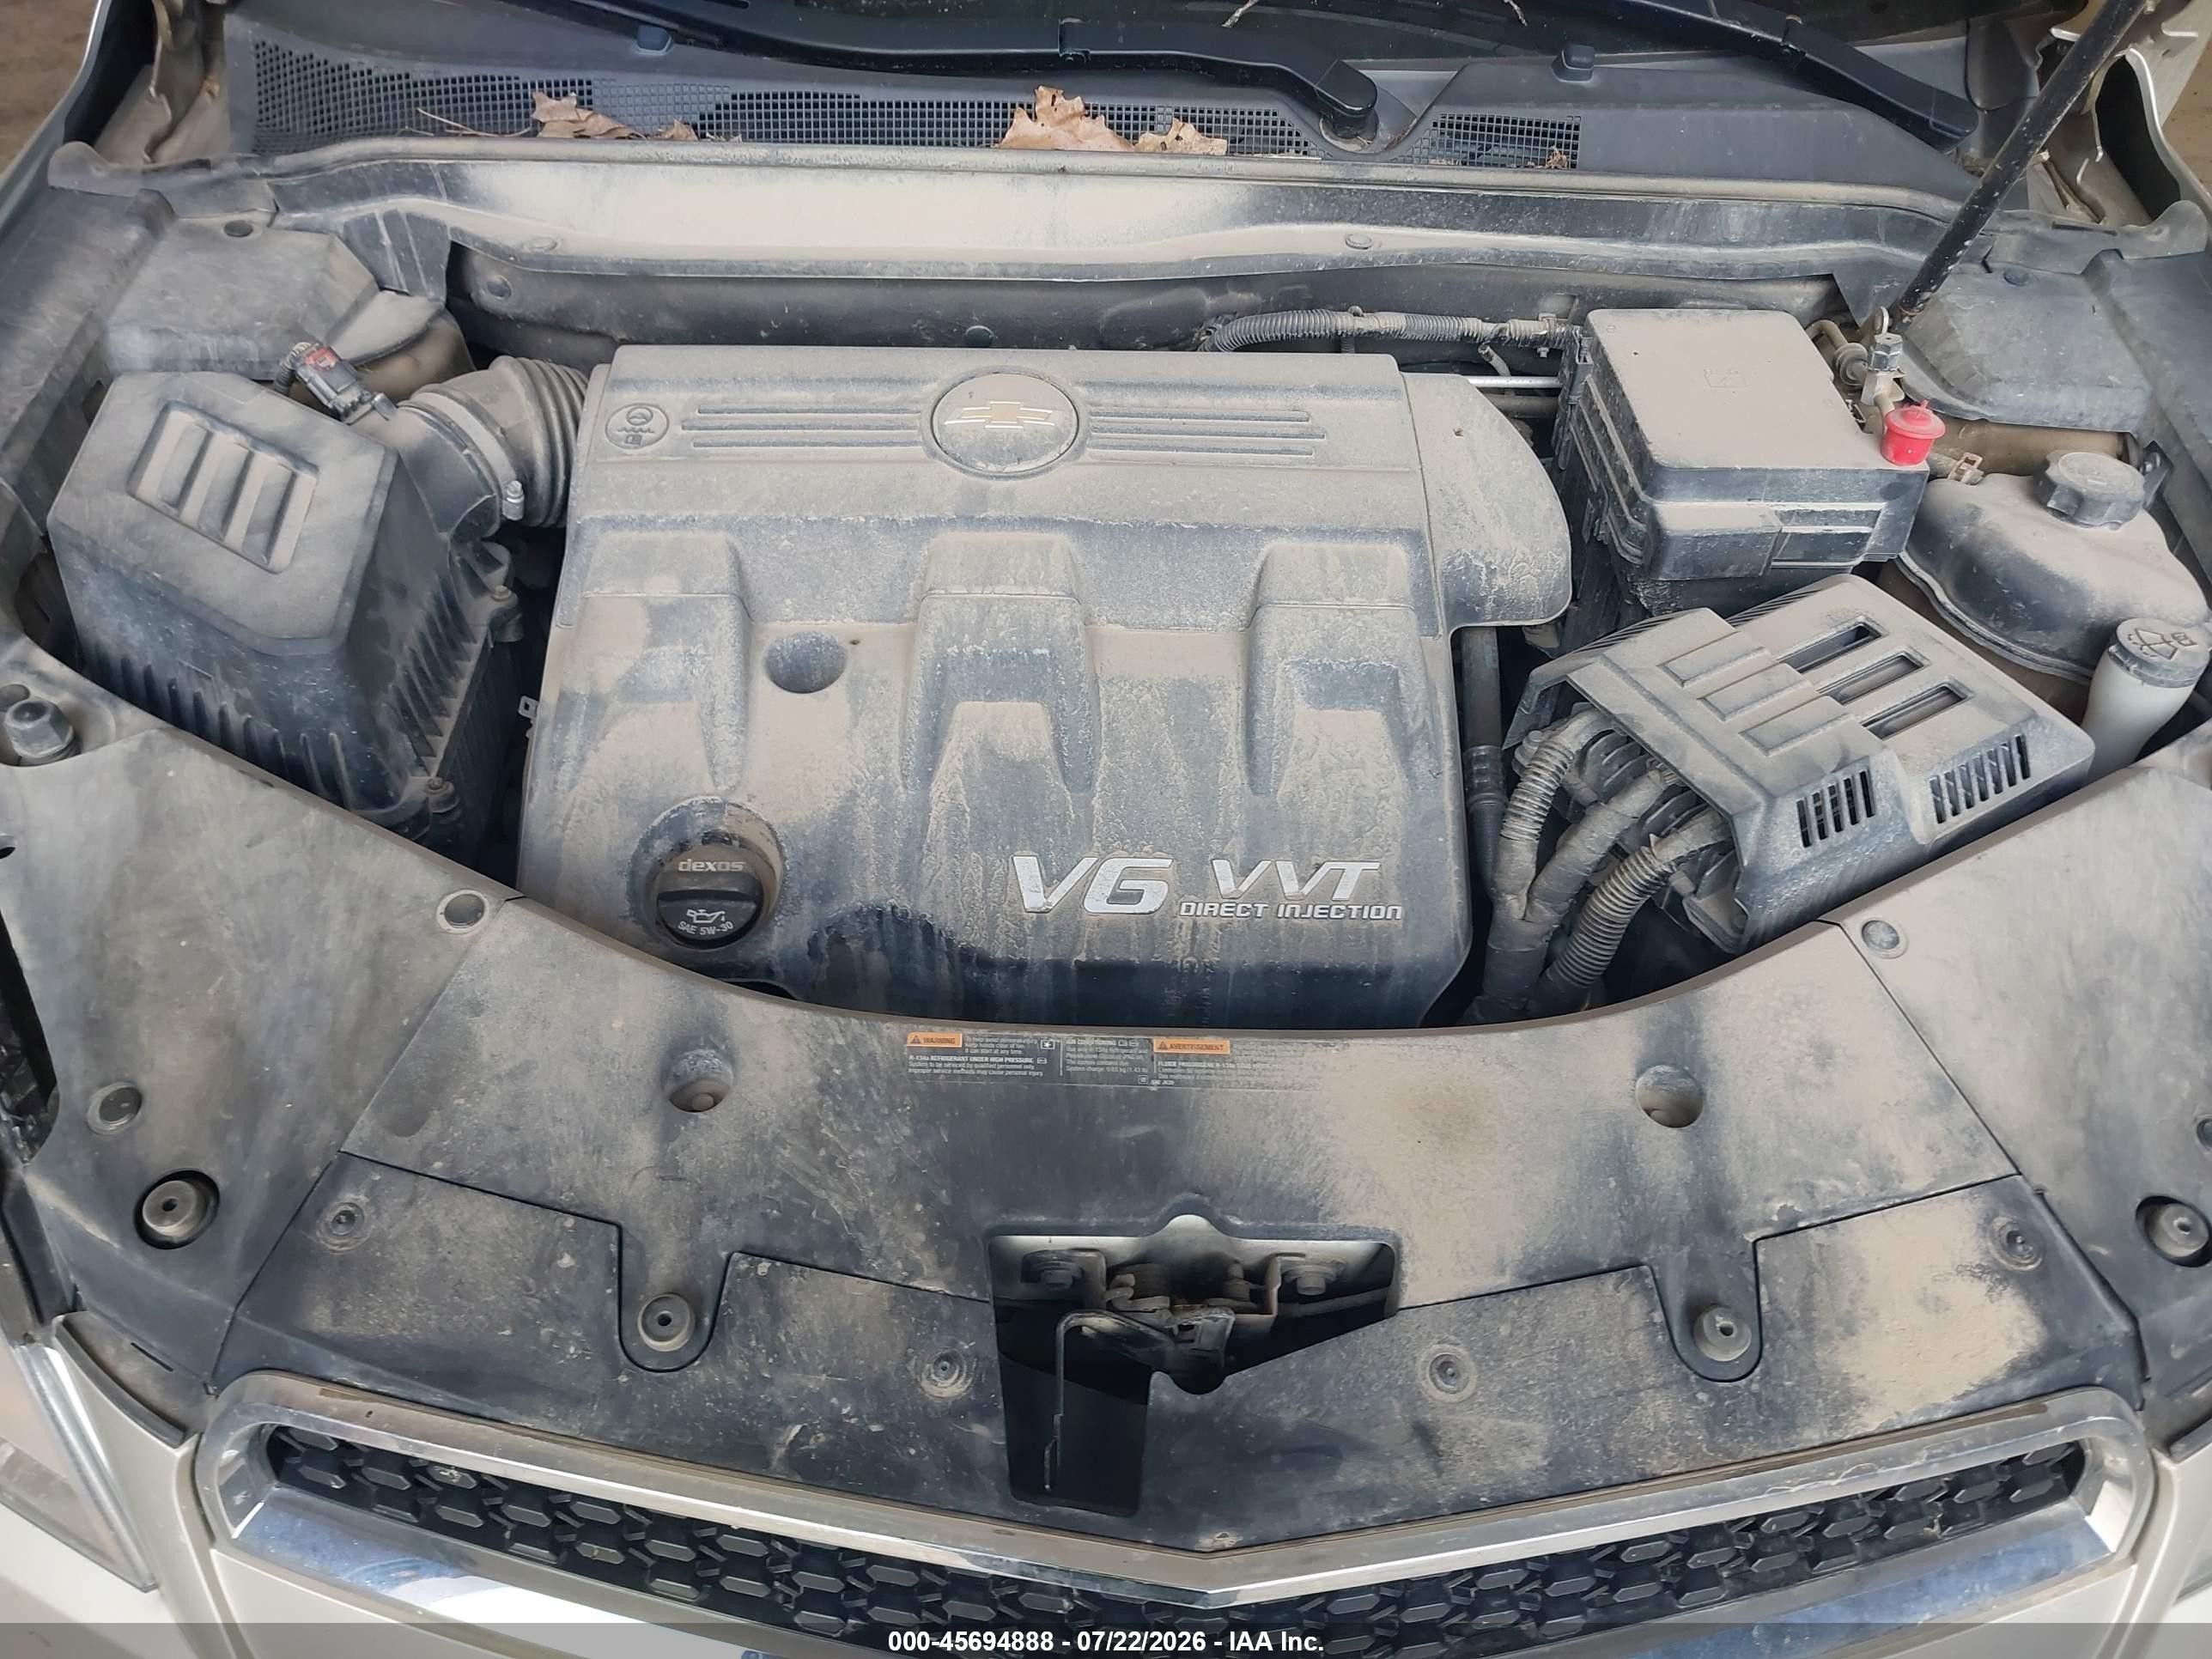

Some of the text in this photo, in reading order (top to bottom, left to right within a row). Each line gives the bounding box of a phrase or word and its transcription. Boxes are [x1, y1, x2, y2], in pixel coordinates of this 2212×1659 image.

[678, 859, 746, 872] dexos
[1012, 855, 1381, 914] V6 VVT
[1179, 902, 1404, 921] DIRECT INJECTION
[678, 921, 734, 936] SAE 5W-30
[1170, 1042, 1224, 1051] AVERTISSEMENT
